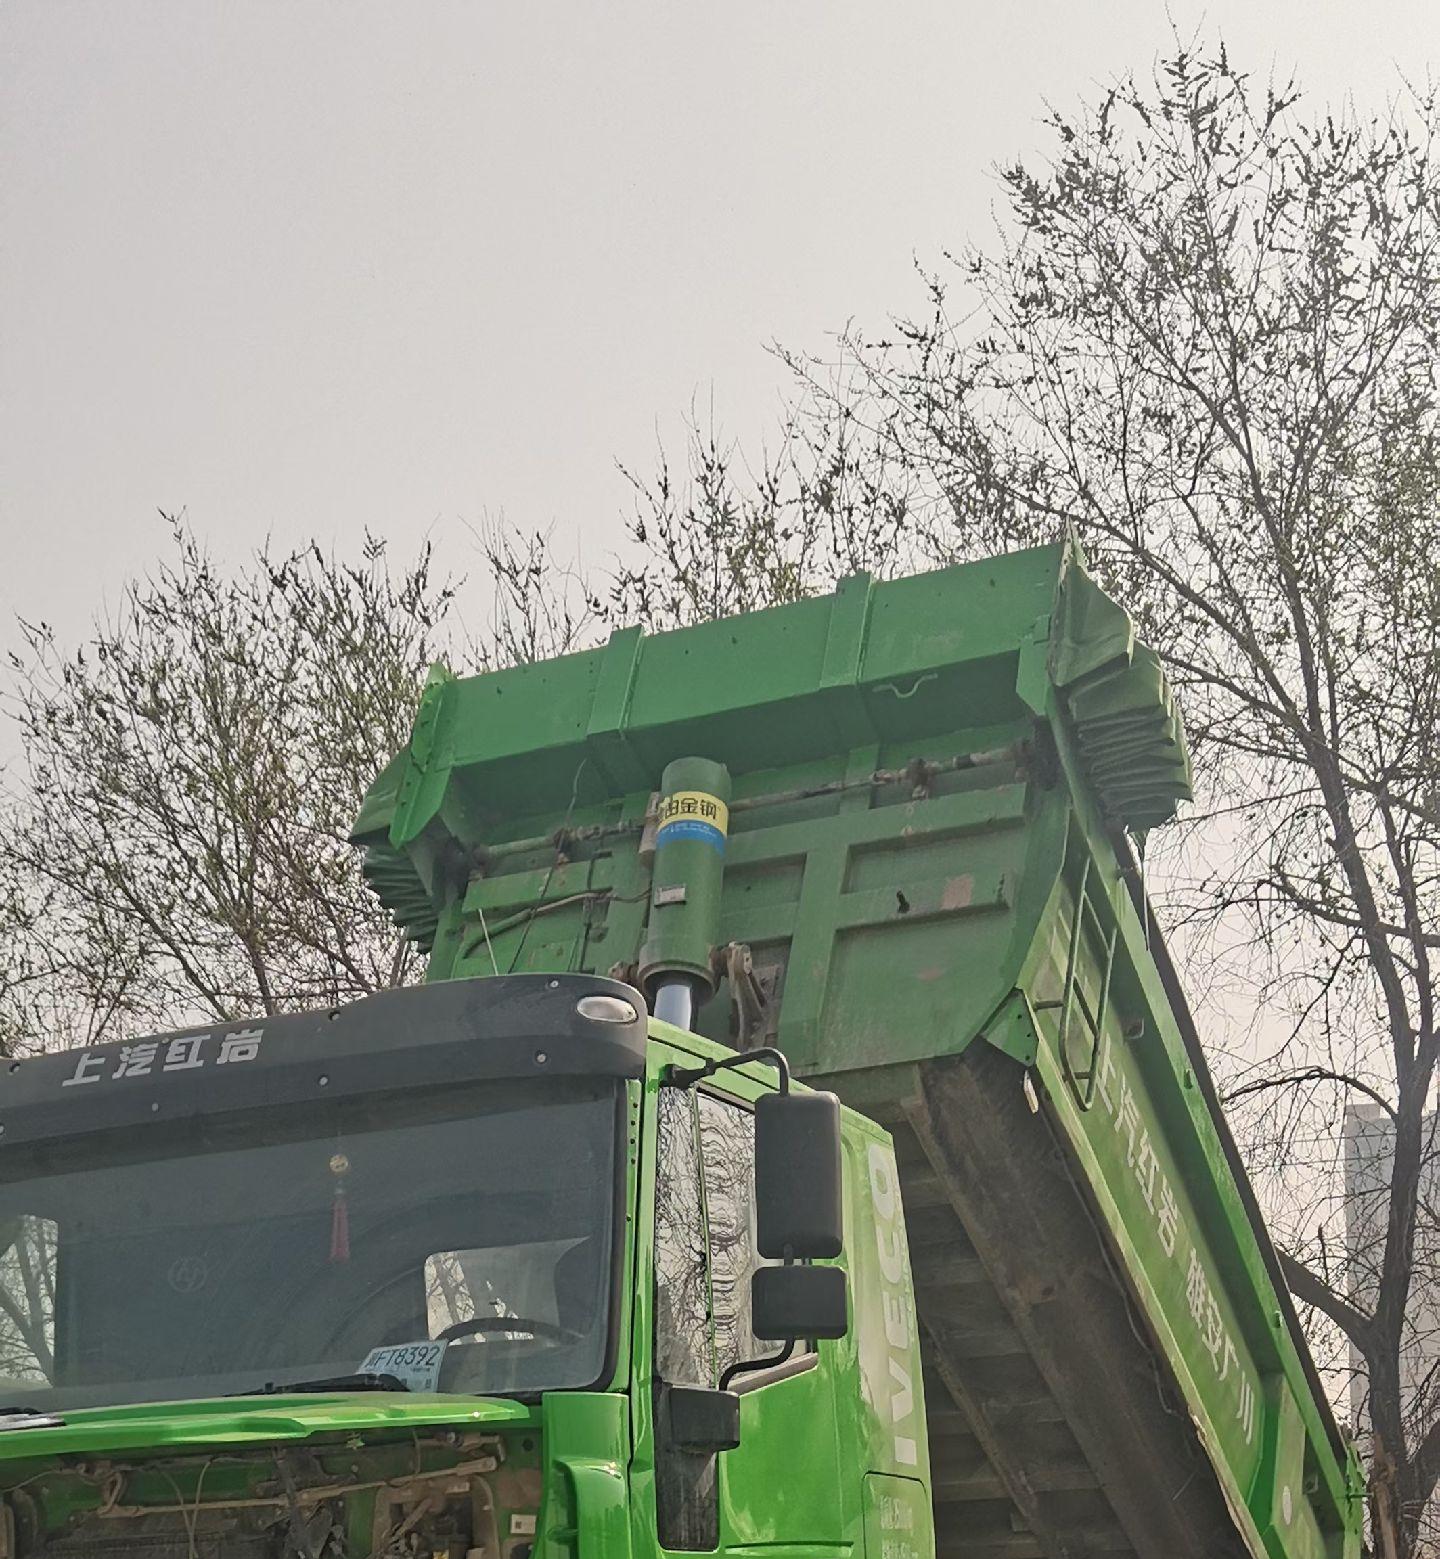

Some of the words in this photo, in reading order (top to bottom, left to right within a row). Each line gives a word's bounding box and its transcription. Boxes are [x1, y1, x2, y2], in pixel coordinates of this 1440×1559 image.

[61, 1028, 264, 1087] 上汽红岩
[868, 1142, 917, 1465] IVECO
